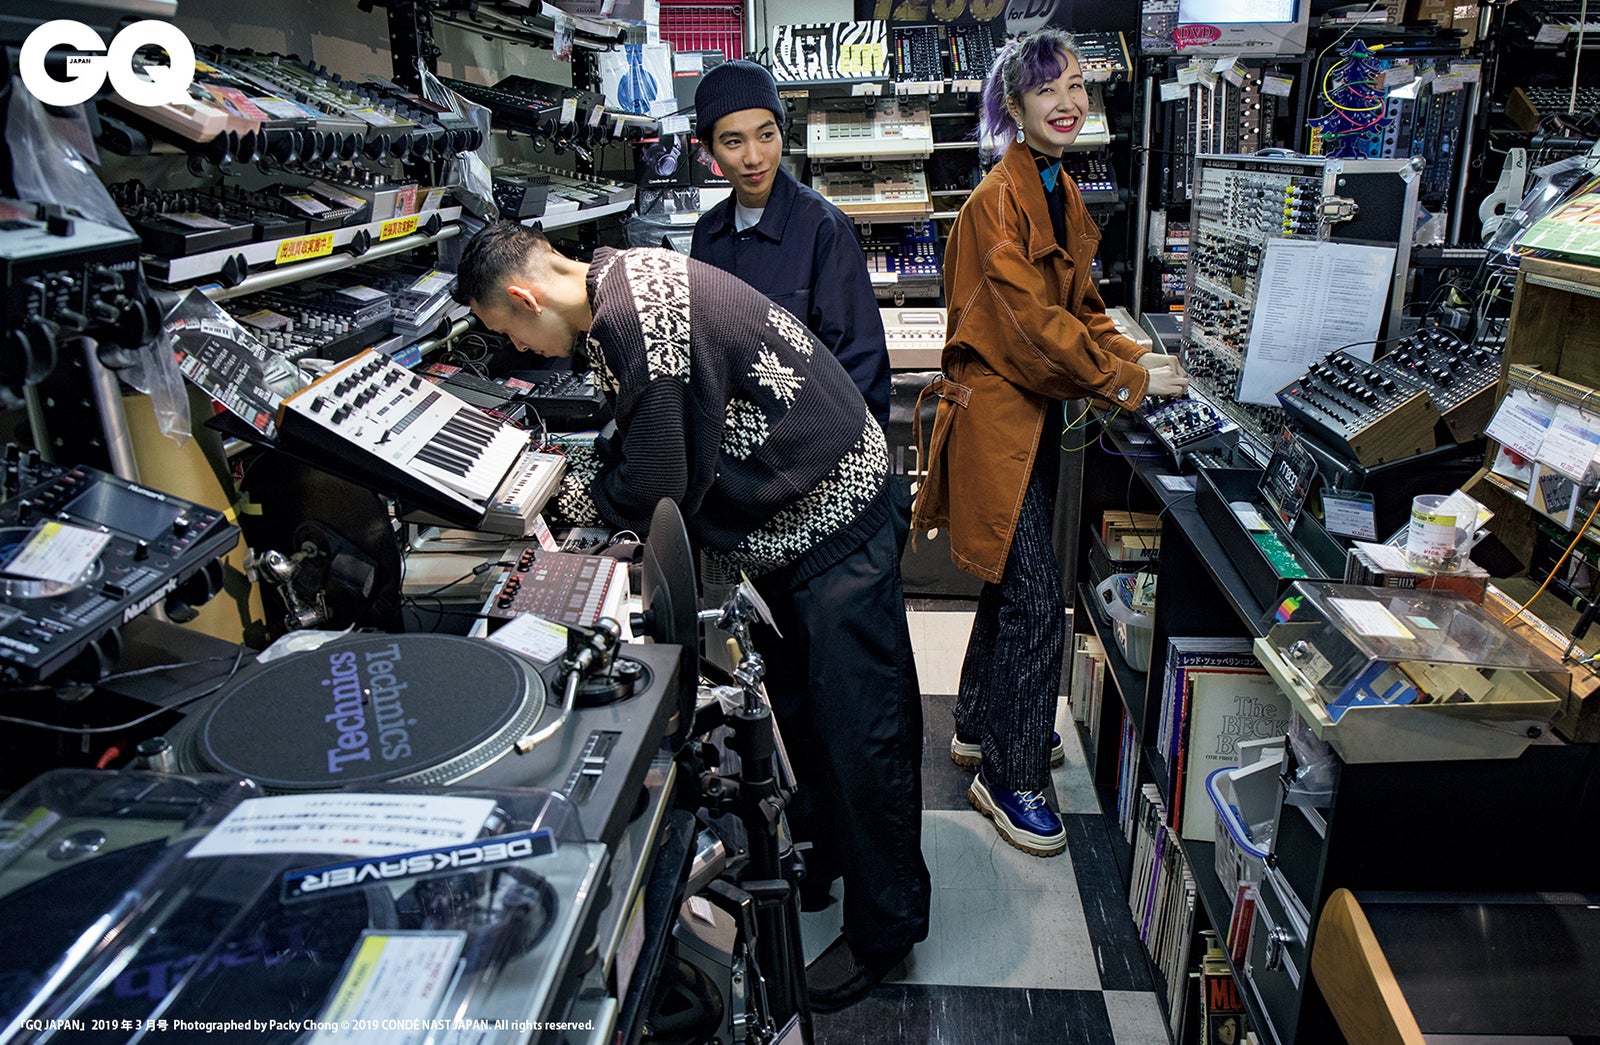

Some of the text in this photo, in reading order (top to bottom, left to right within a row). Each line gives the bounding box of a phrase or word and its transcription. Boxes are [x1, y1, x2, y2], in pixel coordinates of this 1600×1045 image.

[1007, 8, 1024, 20] for
[1181, 27, 1213, 38] DVD
[201, 340, 220, 362] KORG
[1280, 460, 1298, 491] moog
[128, 484, 167, 501] Numark
[123, 577, 179, 623] Numark
[321, 652, 370, 773] Technics
[365, 644, 417, 761] Technics
[1234, 696, 1278, 719] The
[1221, 715, 1289, 738] BECK
[300, 838, 533, 893] DECKSAVER
